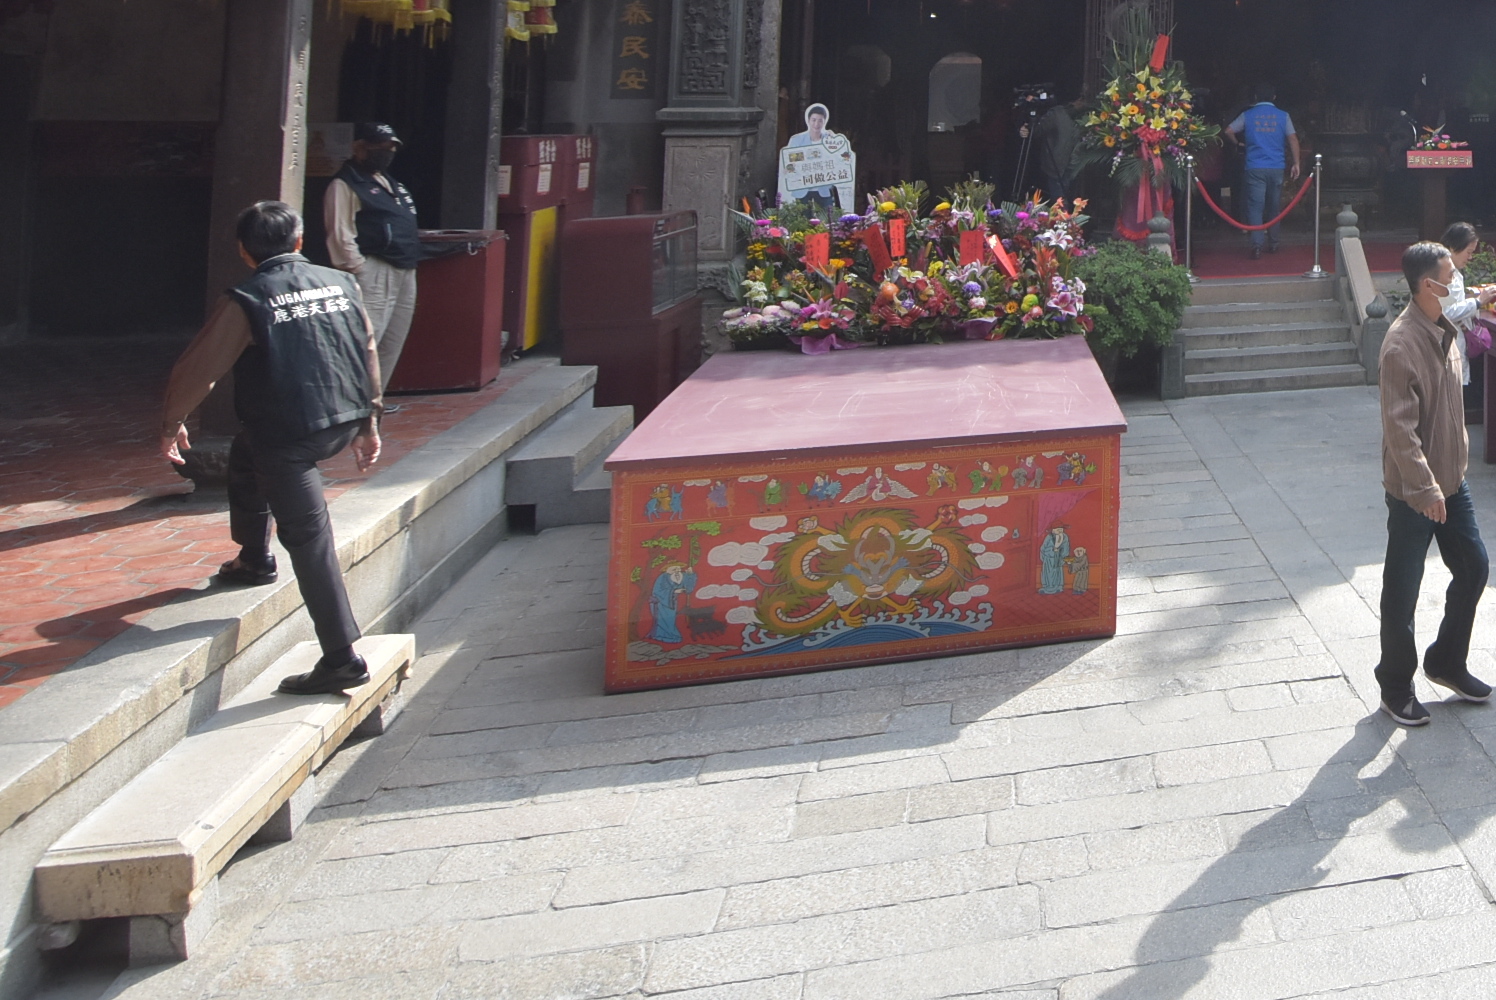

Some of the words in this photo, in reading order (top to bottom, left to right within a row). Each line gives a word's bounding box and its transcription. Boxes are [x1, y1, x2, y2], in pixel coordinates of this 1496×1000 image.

[791, 169, 849, 185] 一同做公益
[273, 297, 350, 325] 鹿港天后宮
